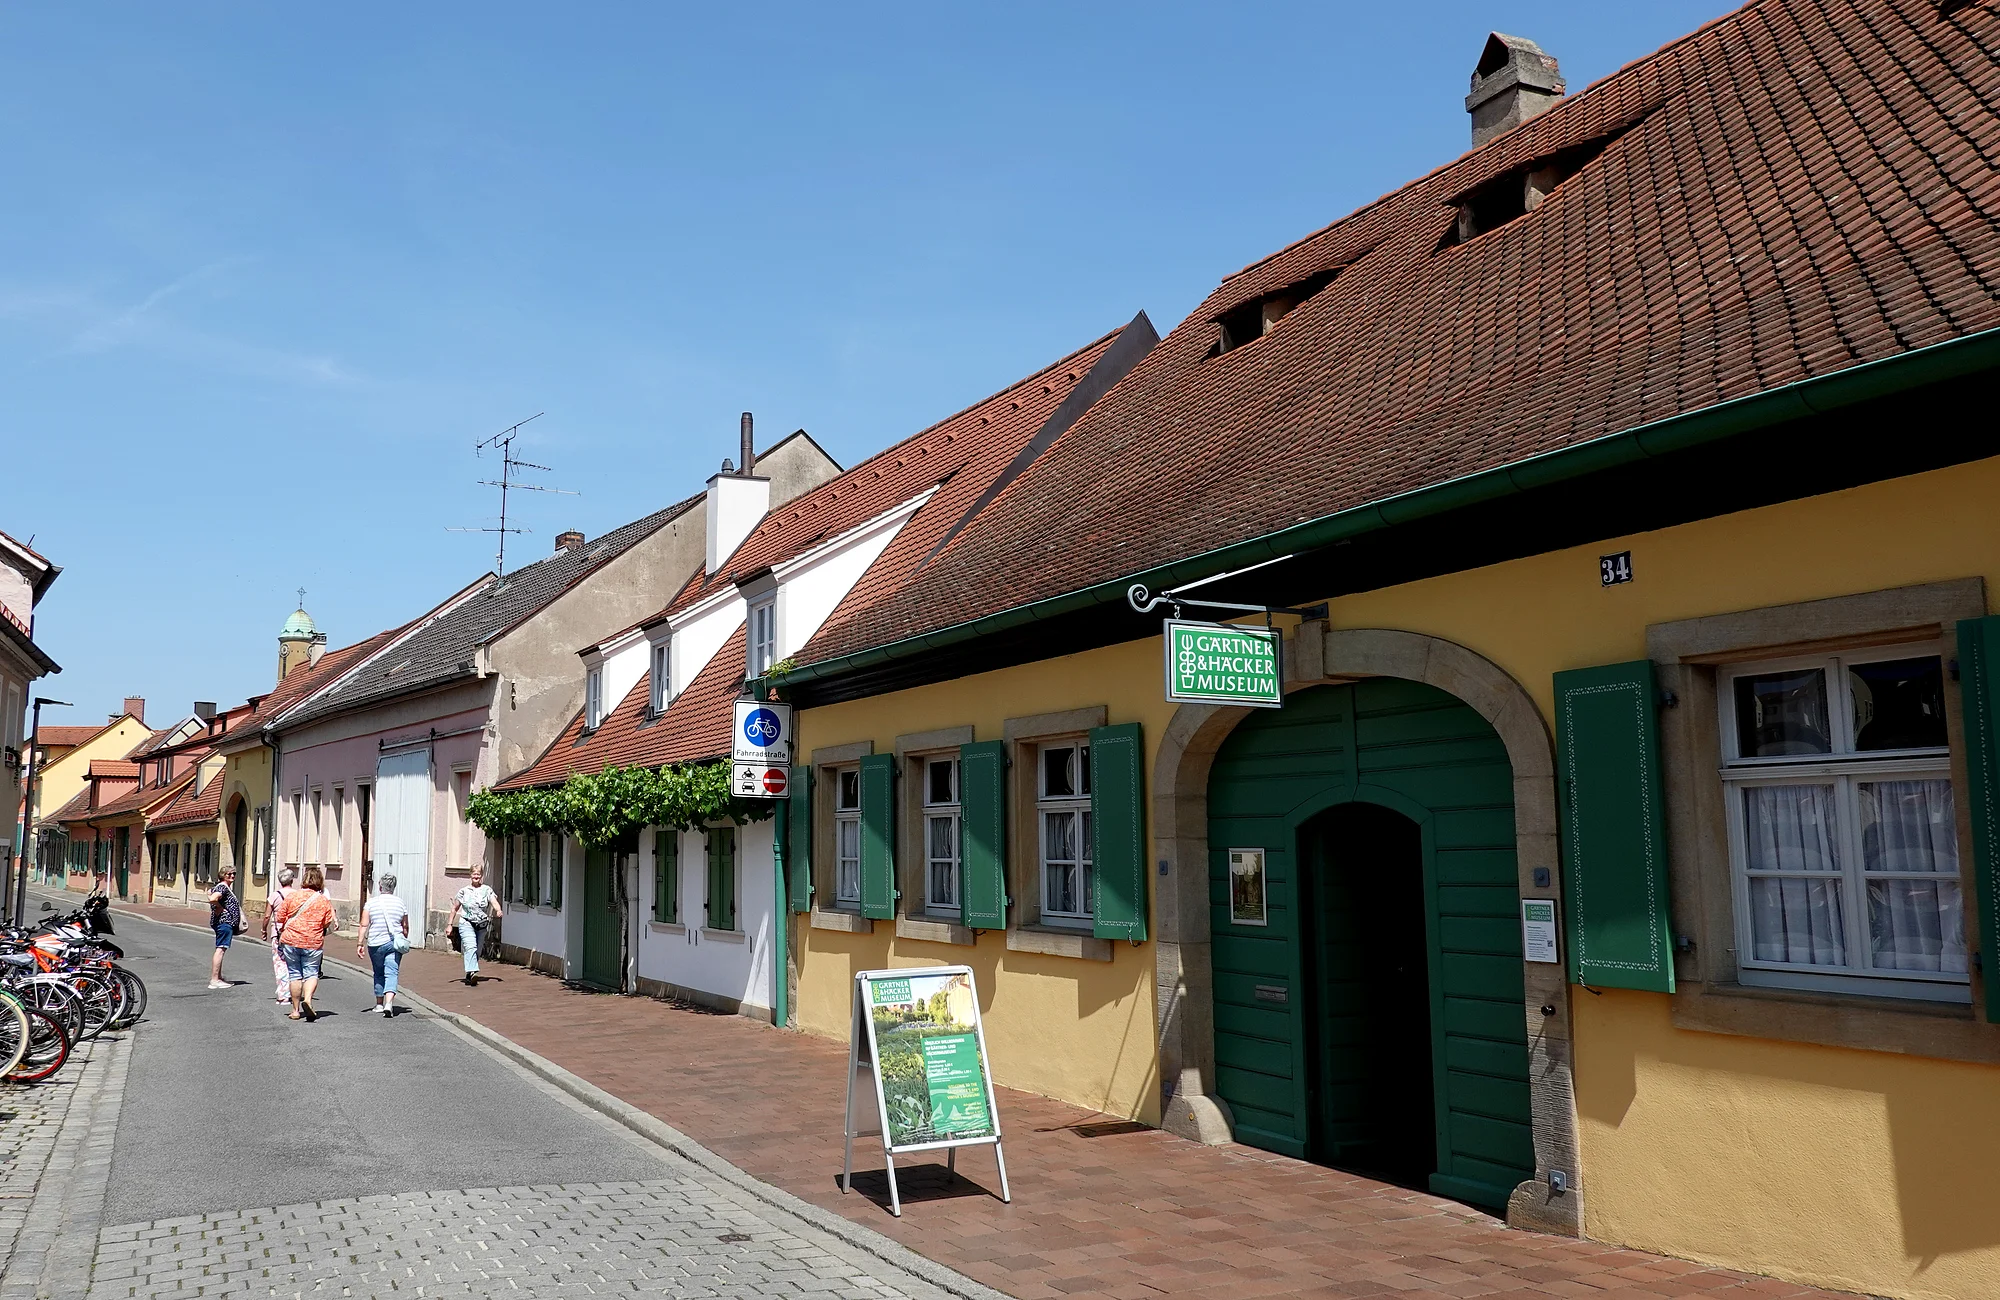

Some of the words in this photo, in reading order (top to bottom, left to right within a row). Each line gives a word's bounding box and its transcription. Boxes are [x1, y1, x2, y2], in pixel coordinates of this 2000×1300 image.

[1602, 556, 1629, 583] 34
[1196, 636, 1274, 656] GÄRTNER
[1197, 655, 1275, 675] &HÄCKER
[1196, 674, 1275, 694] MUSEUM
[736, 749, 786, 759] Fahrradstraße
[880, 994, 912, 1002] MUSEUM
